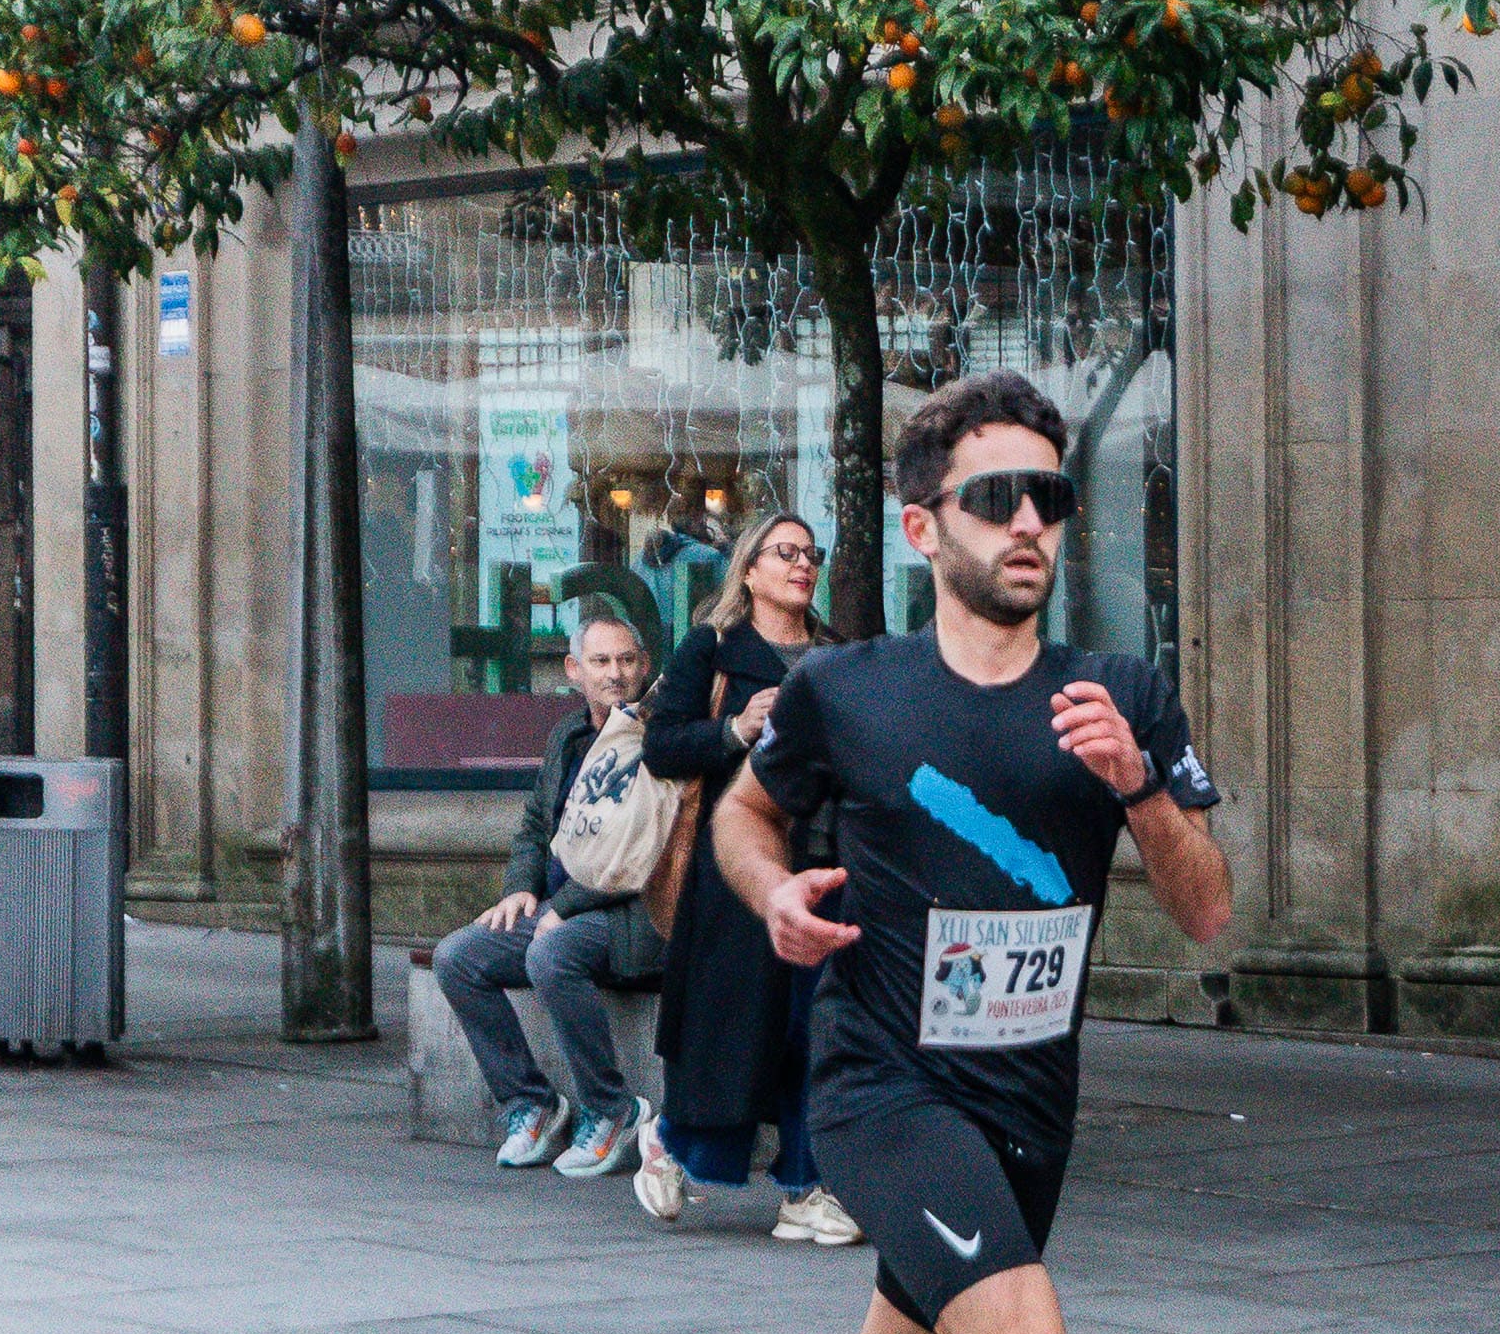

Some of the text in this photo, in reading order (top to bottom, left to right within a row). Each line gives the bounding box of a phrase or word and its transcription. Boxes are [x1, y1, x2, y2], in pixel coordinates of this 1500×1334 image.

[975, 917, 1010, 947] SAN
[1014, 913, 1083, 946] SILVESTRE
[1005, 945, 1065, 994] 729
[986, 995, 1048, 1018] PONTEVEDRA
